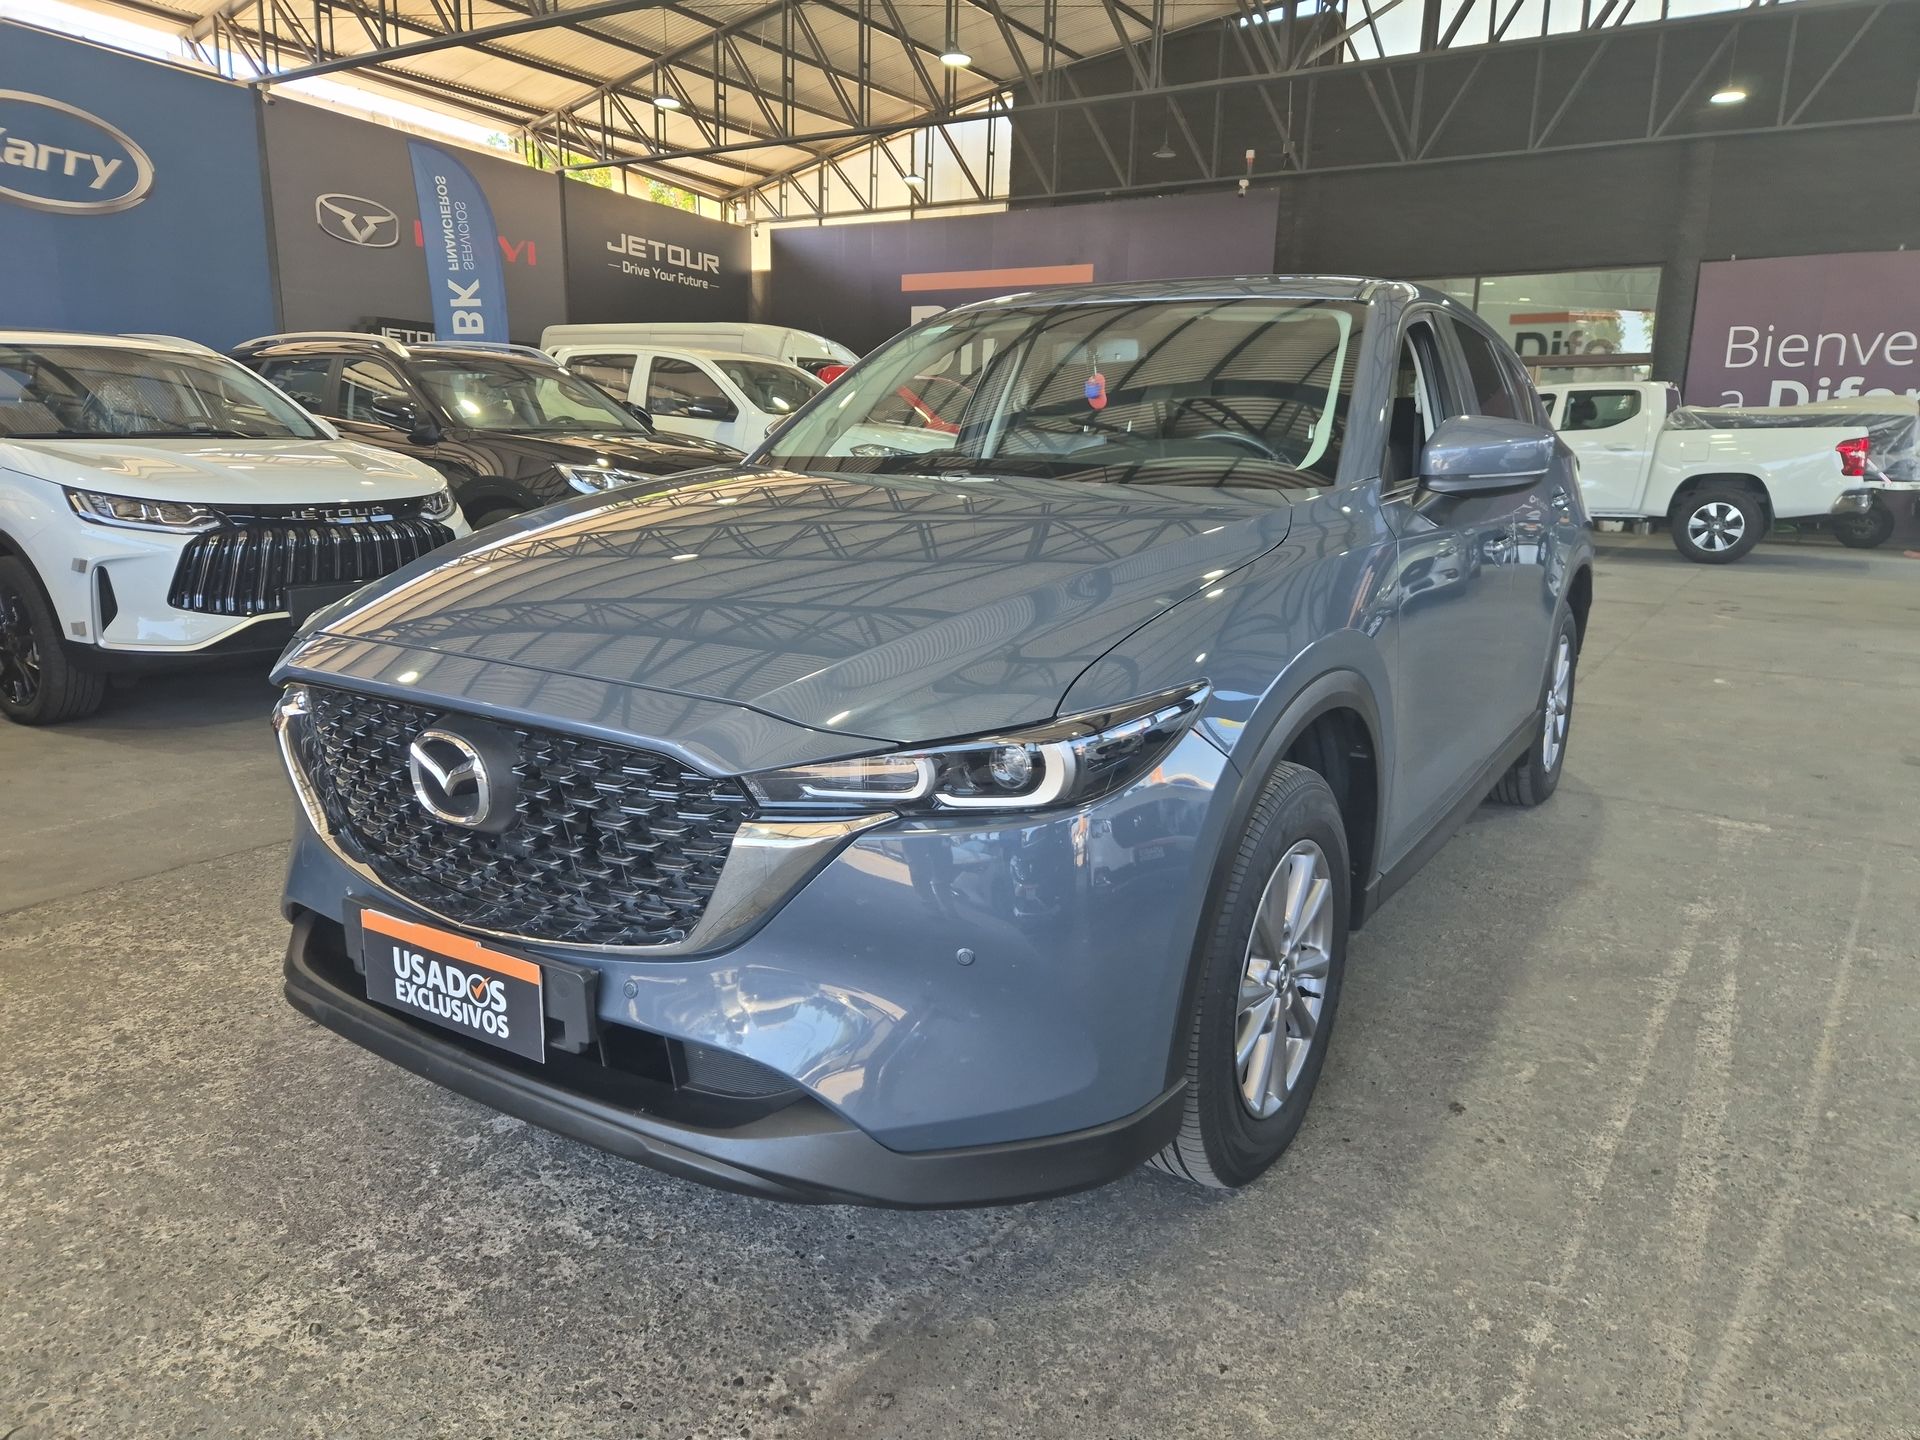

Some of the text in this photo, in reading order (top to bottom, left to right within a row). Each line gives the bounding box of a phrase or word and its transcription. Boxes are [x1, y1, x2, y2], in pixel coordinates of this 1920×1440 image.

[0, 127, 123, 190] arry
[606, 233, 720, 275] JETOUR
[622, 260, 709, 289] Drive Your Future
[1724, 324, 1919, 368] Bienve
[392, 946, 507, 1013] USADOS
[394, 978, 510, 1039] EXCLUSIVOS
